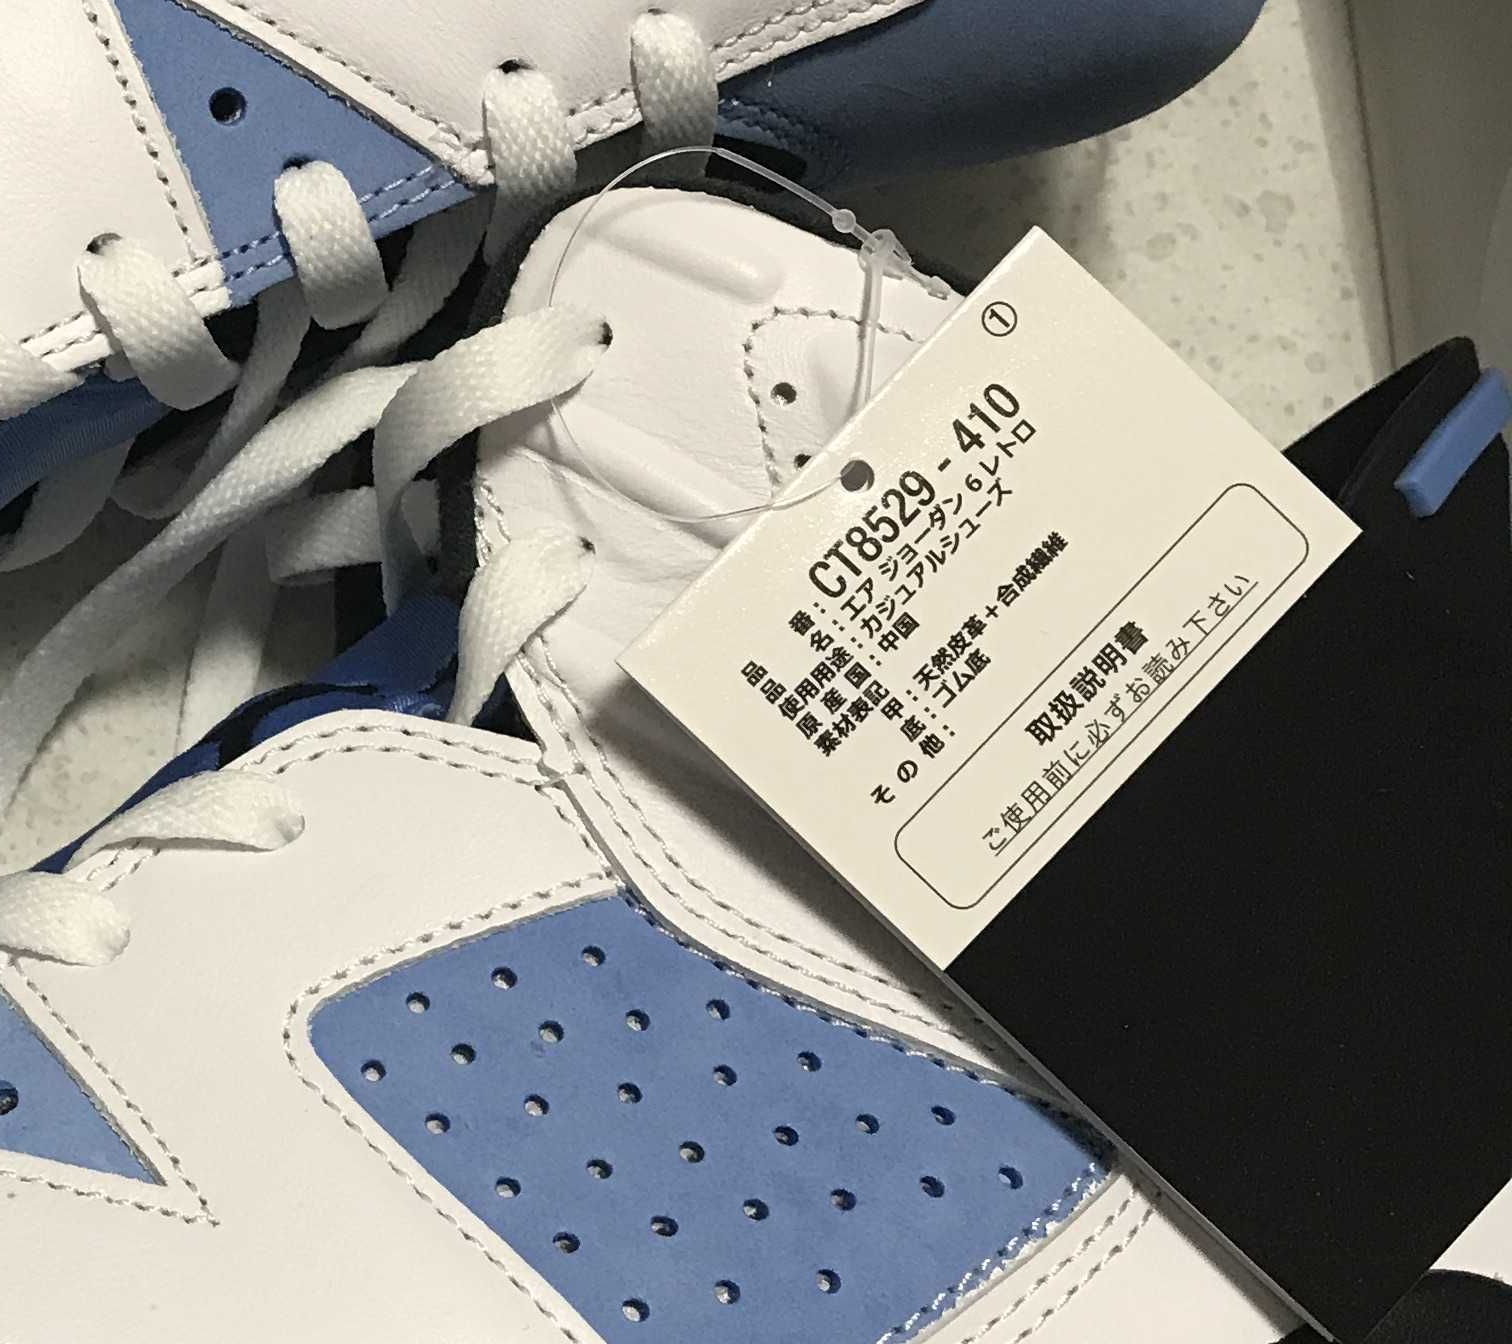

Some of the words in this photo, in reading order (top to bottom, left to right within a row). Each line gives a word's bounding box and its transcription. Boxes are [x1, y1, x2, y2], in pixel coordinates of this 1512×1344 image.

[807, 469, 936, 599] CT8529
[951, 382, 1020, 453] 410
[839, 575, 874, 622] エア
[877, 492, 963, 582] ジョーダン
[964, 472, 983, 492] 6
[977, 418, 1037, 477] レトロ
[812, 678, 890, 757] 素材表記
[931, 646, 992, 709] ゴム底
[981, 574, 1257, 851] ご使用前に必ずお読み下さい
[1023, 620, 1149, 746] 取扱説明書
